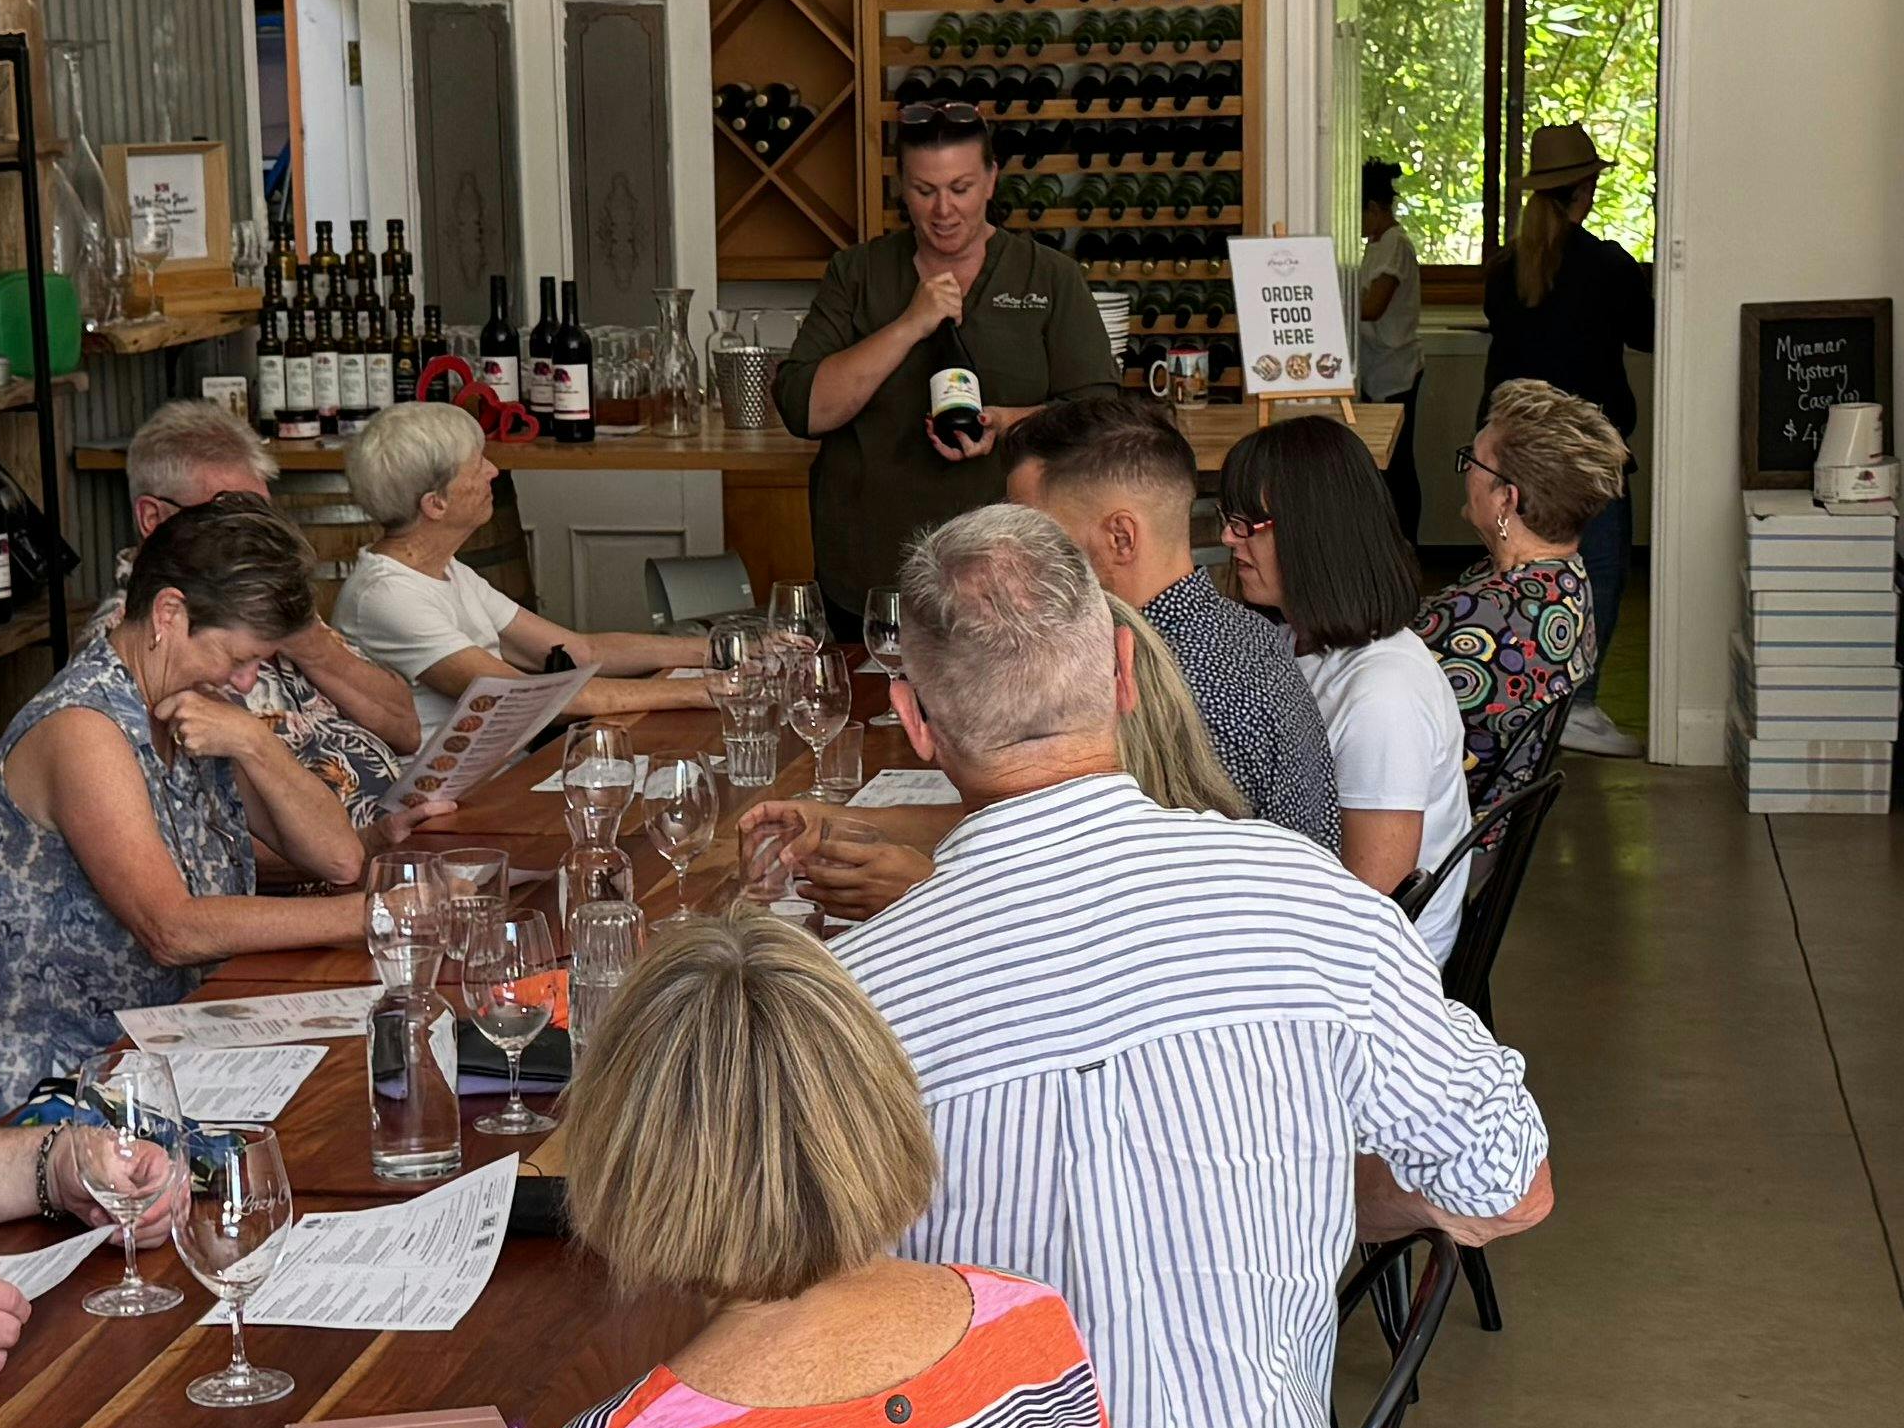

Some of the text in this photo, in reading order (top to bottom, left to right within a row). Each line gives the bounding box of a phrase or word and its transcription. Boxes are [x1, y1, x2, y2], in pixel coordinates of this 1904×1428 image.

[1262, 285, 1313, 302] ORDER
[1270, 307, 1312, 324] FOOD
[1273, 328, 1314, 346] HERE
[1776, 335, 1846, 362] Miramar
[1787, 362, 1848, 393] Mystery
[1798, 393, 1833, 411] Case
